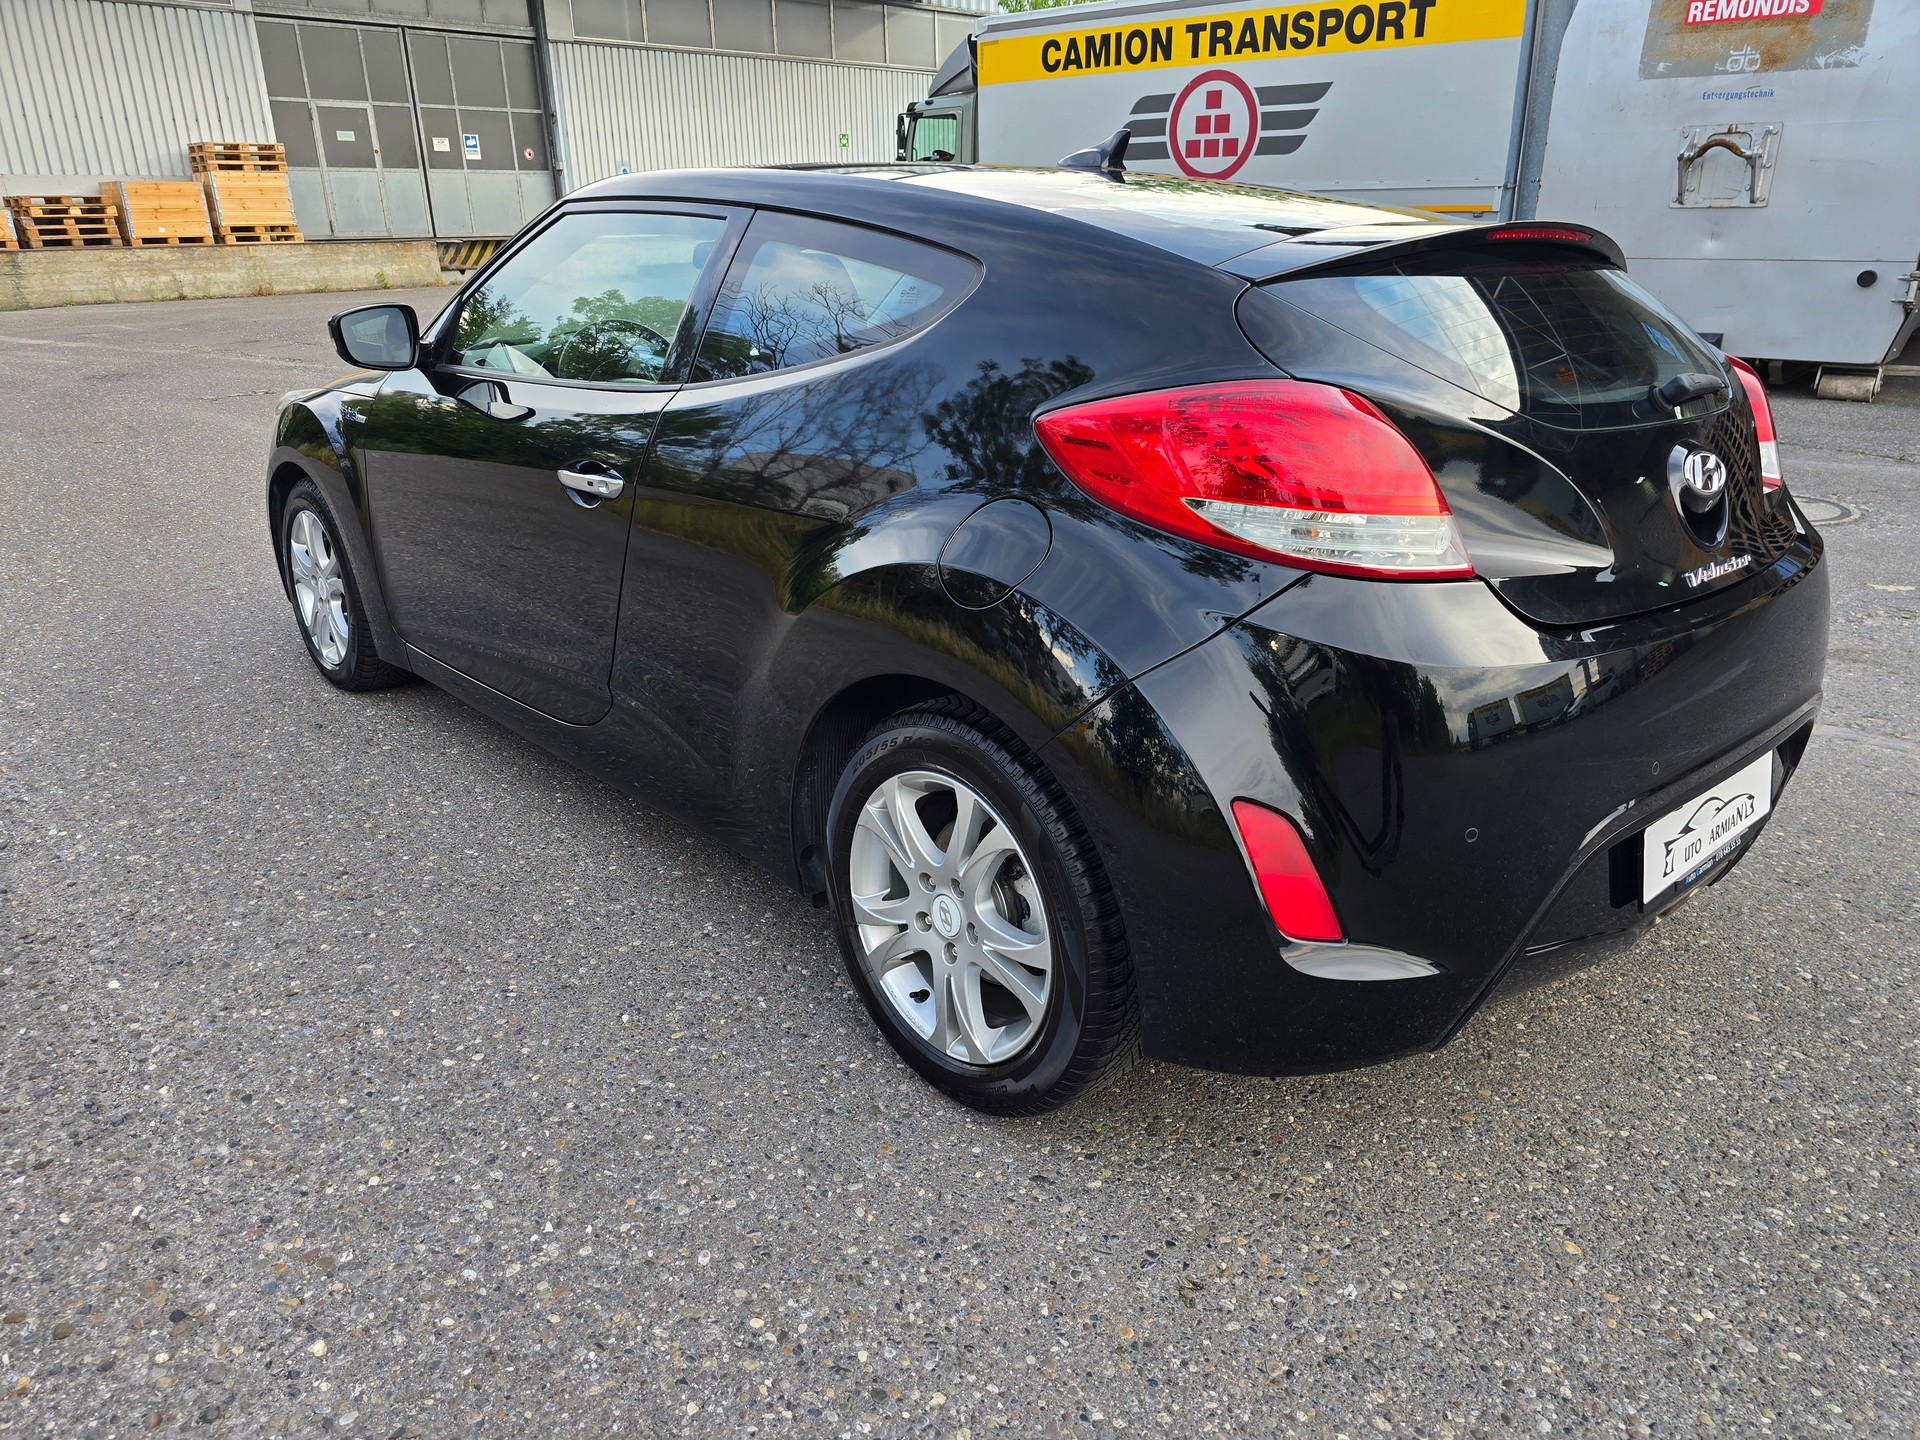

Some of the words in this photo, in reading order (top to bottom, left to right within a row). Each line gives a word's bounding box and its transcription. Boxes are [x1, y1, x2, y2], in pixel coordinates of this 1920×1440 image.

[1687, 0, 1810, 23] REMONDIS
[1041, 25, 1173, 73] CAMION
[1185, 0, 1437, 58] TRANSPORT
[1702, 89, 1775, 101] Entsorgungstechnik
[852, 736, 899, 776] 205/55
